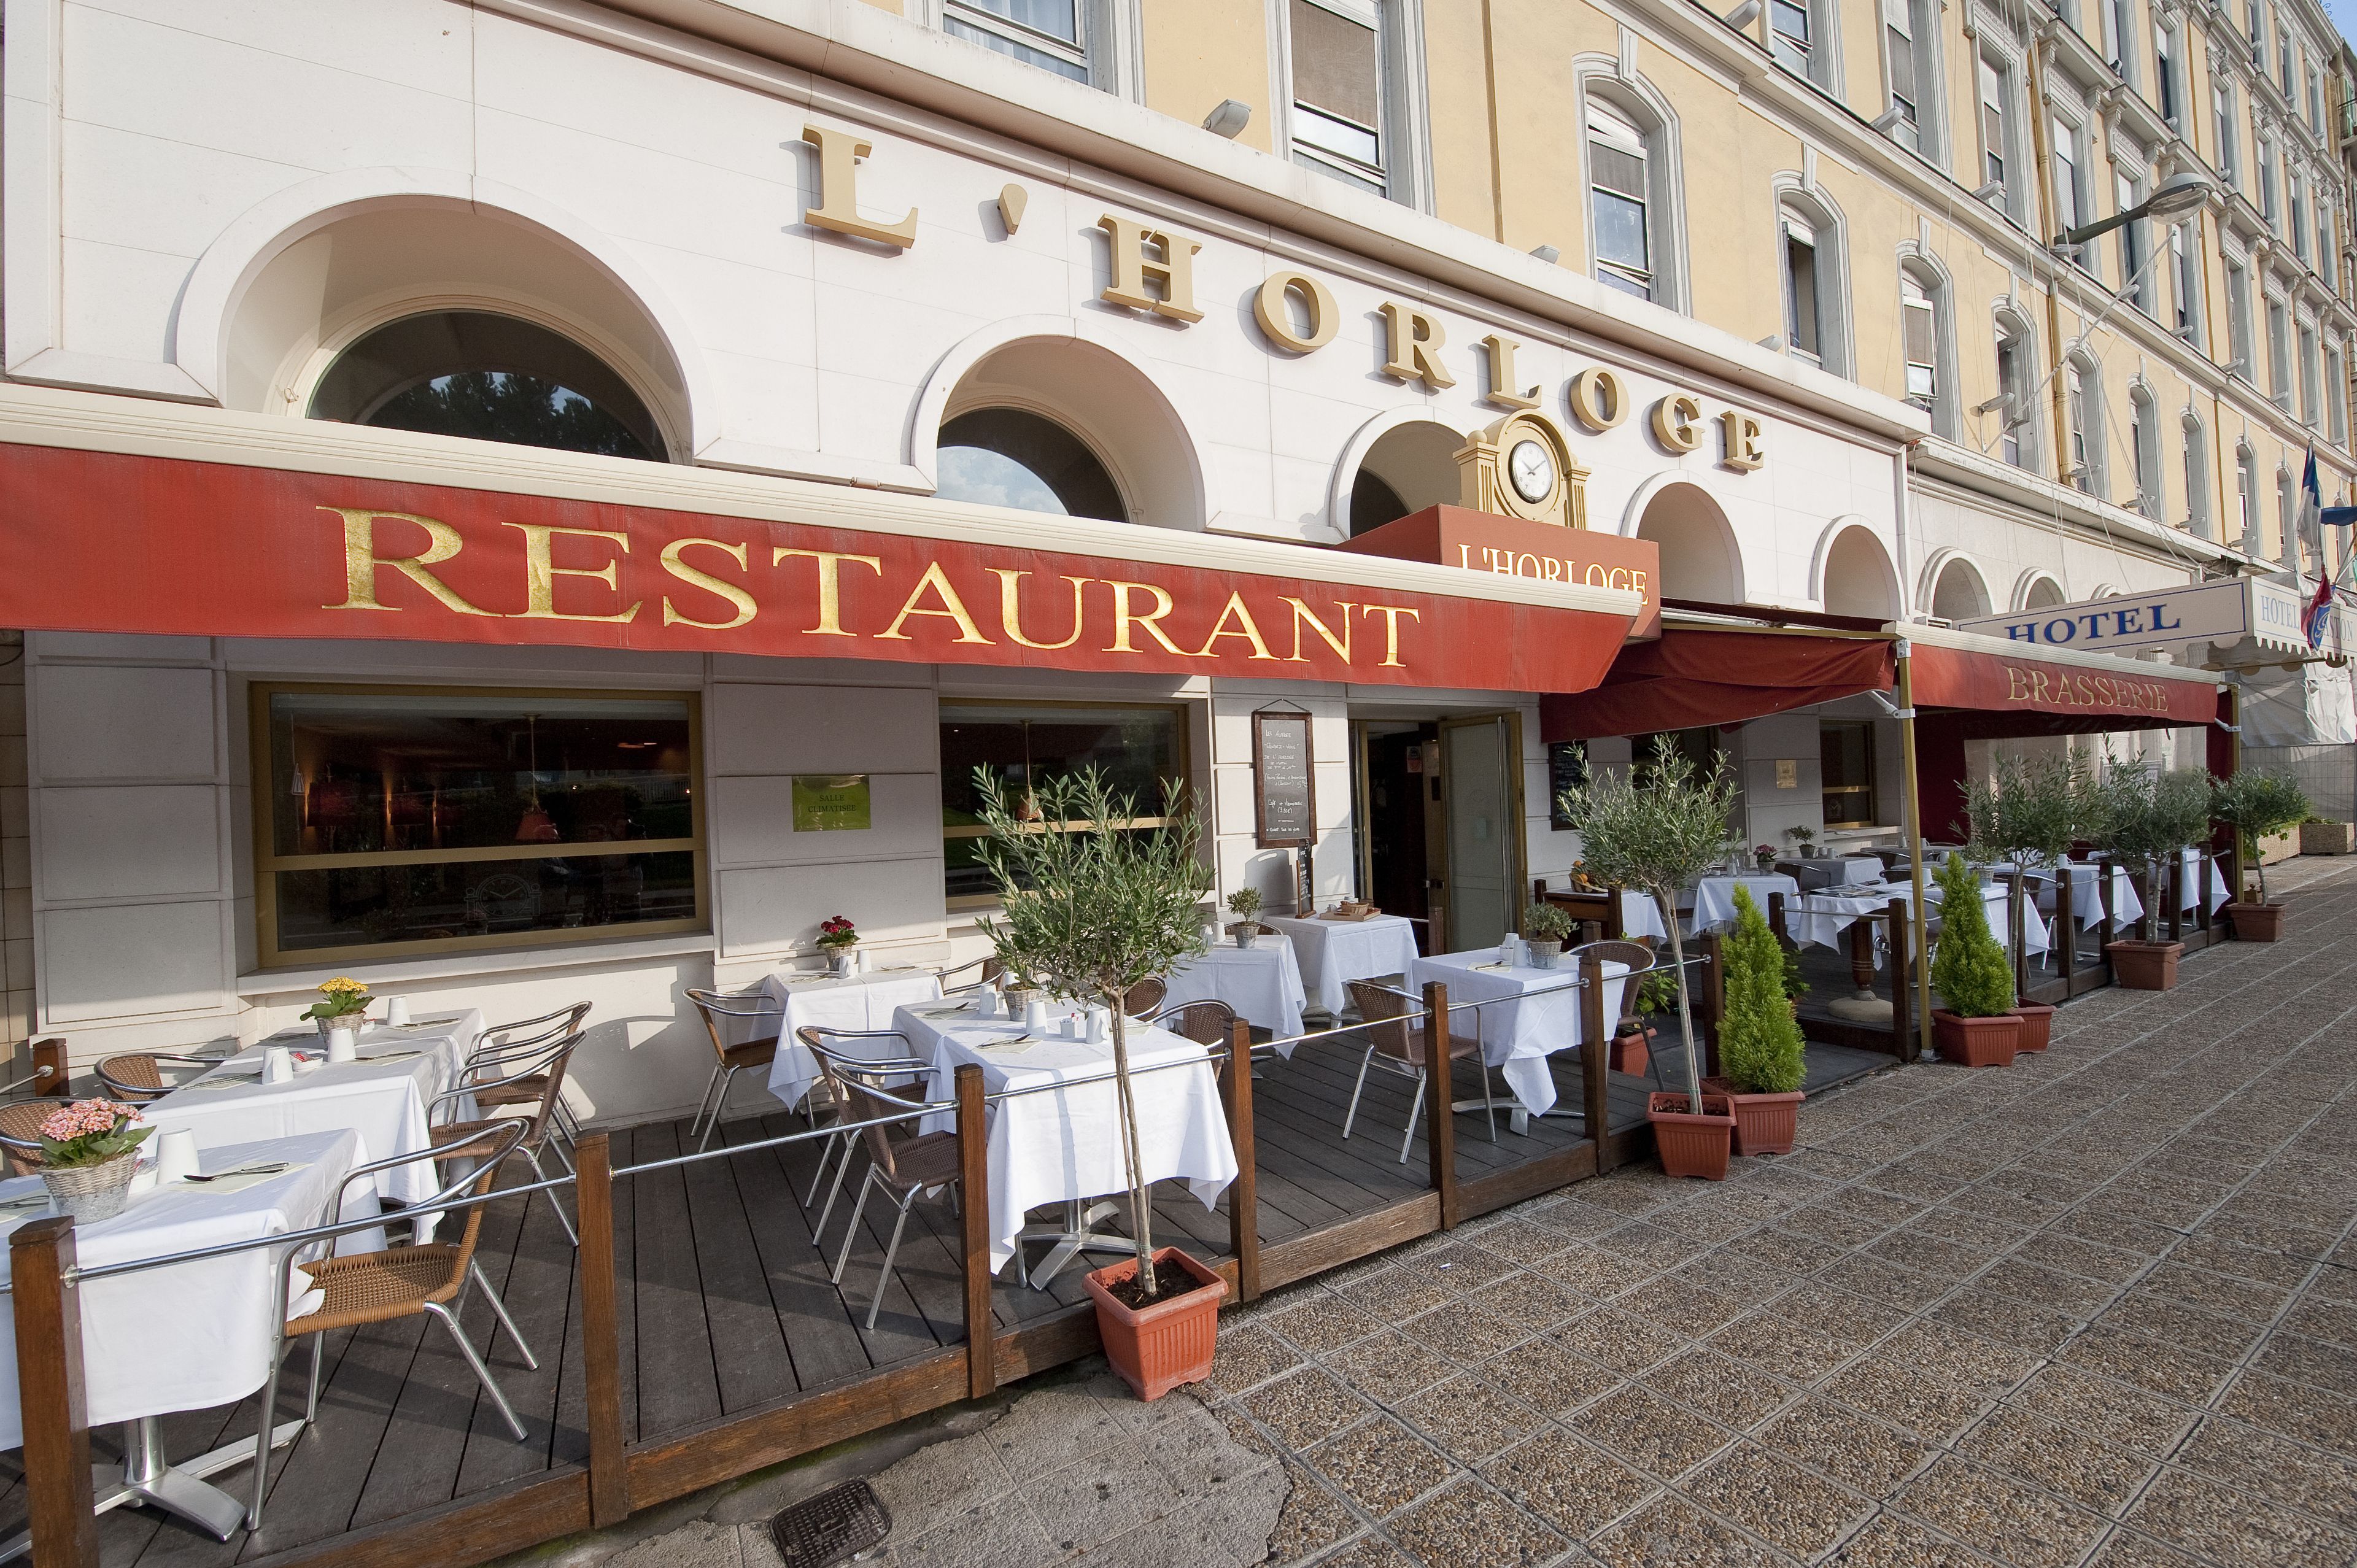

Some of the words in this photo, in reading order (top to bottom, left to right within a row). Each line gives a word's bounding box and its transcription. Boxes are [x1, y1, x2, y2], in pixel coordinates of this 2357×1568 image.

[315, 505, 1420, 668] RESTAURANT
[2004, 603, 2181, 644] HOTEL
[2261, 595, 2300, 630] HOTEL
[2002, 665, 2169, 713] BRASSERIE
